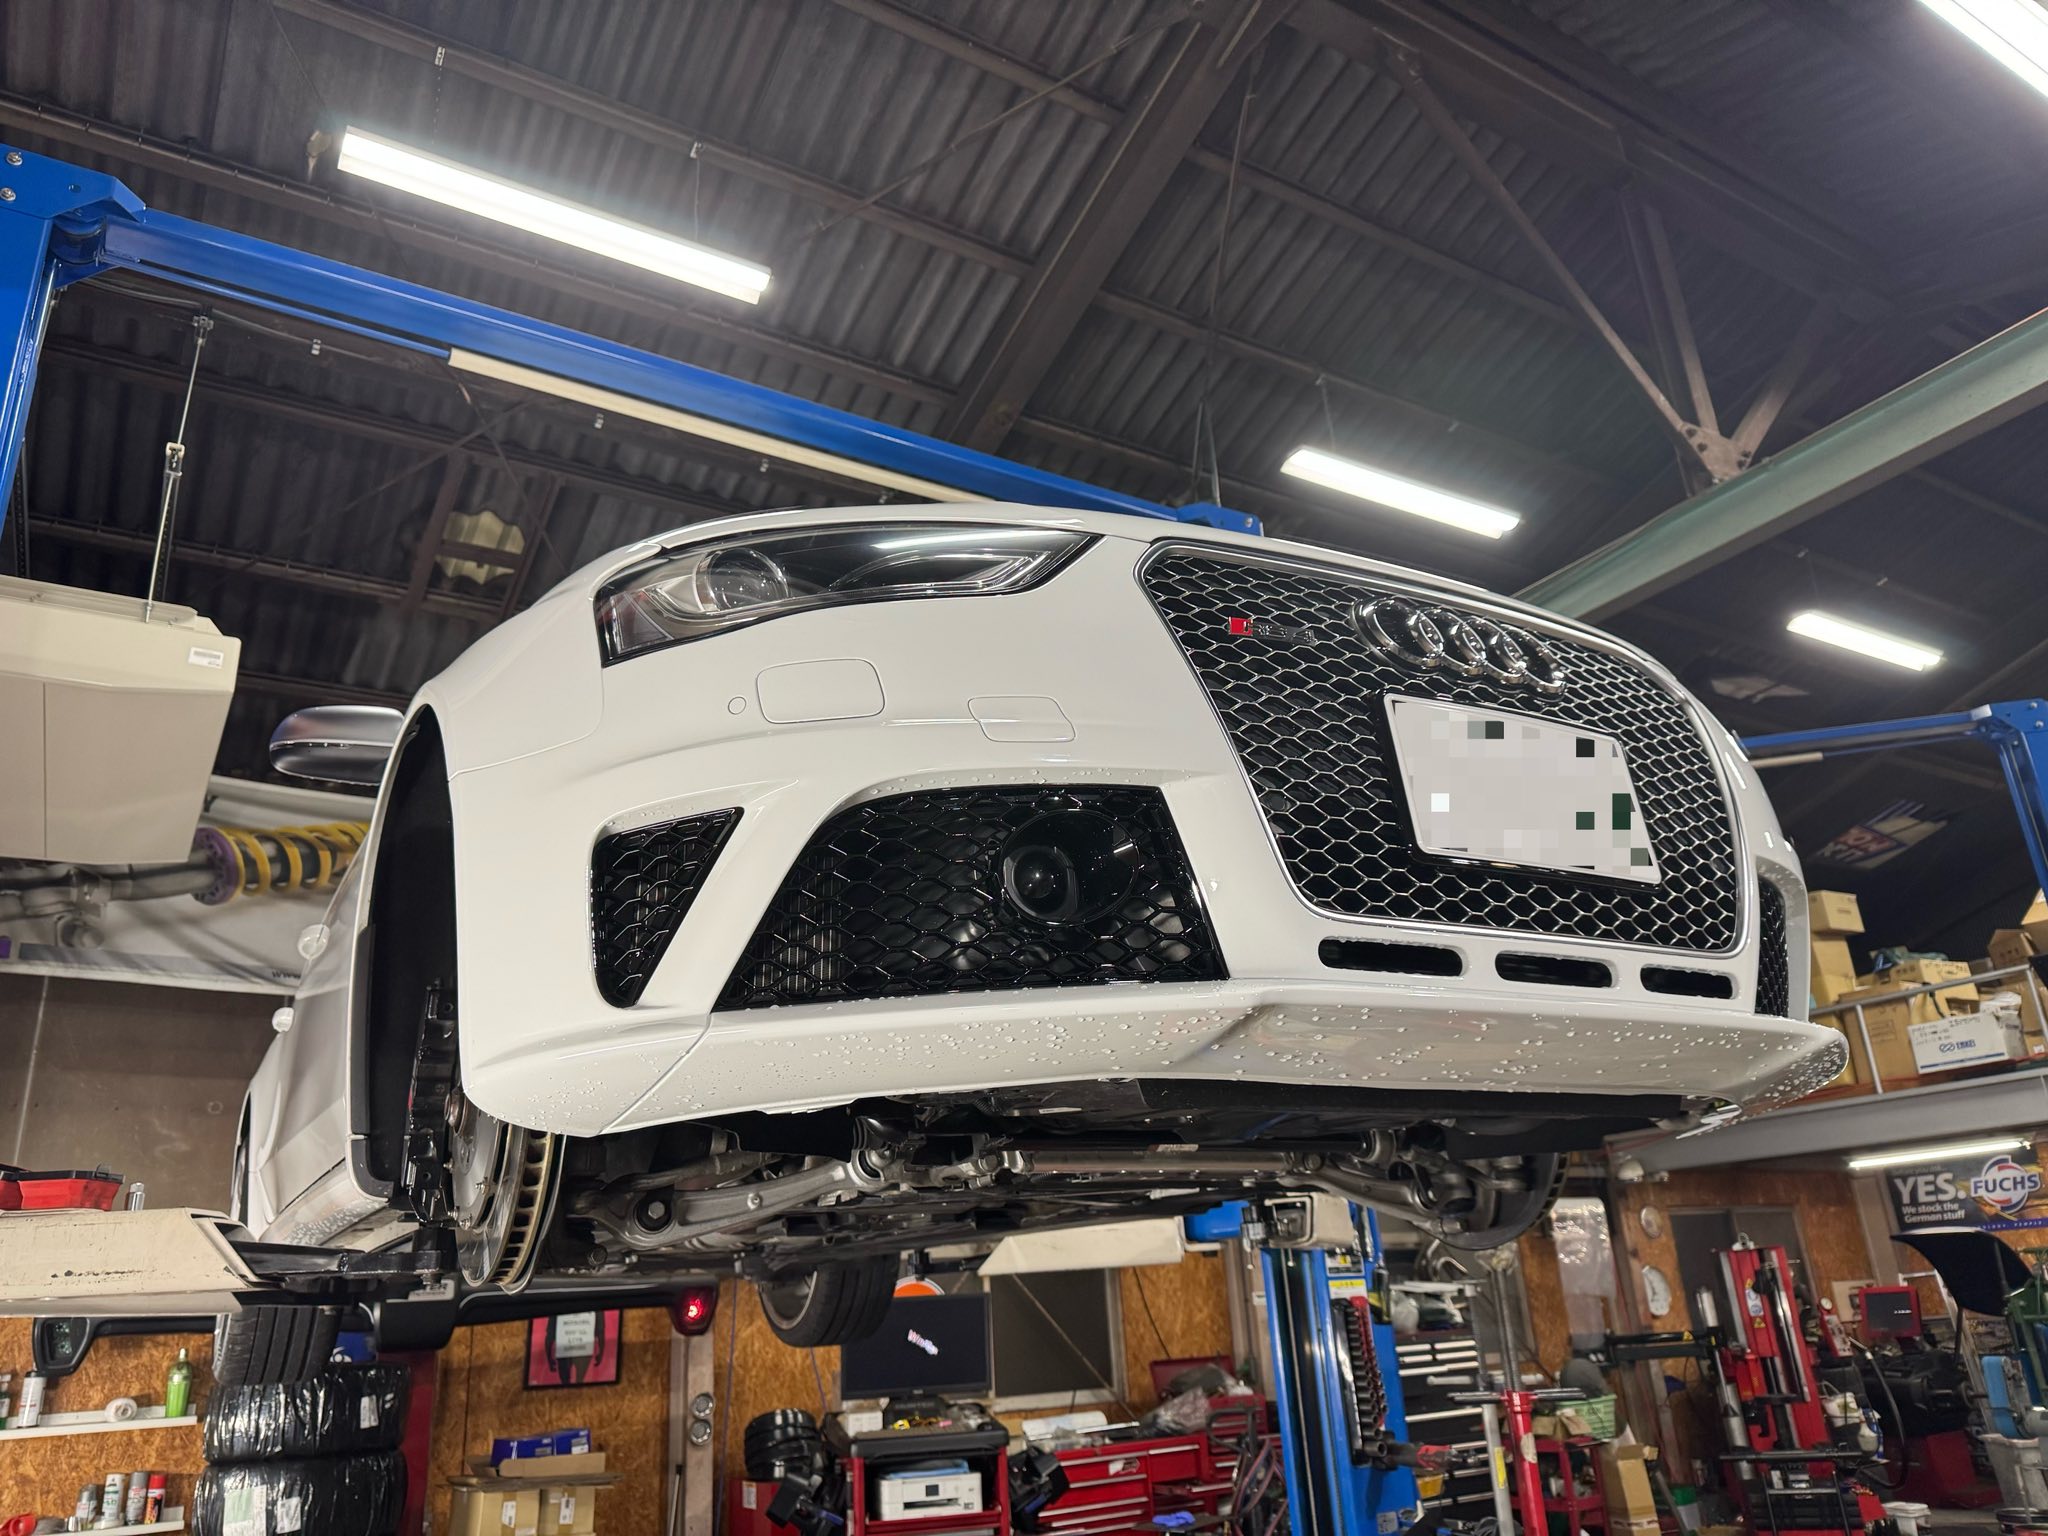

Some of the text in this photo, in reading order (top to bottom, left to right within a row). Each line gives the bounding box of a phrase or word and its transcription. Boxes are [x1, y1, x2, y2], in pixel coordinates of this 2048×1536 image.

[1894, 1172, 1967, 1204] YES.
[1973, 1173, 2039, 1195] FUCHS
[1902, 1201, 1960, 1214] We stock the
[1904, 1209, 1966, 1224] German stuff
